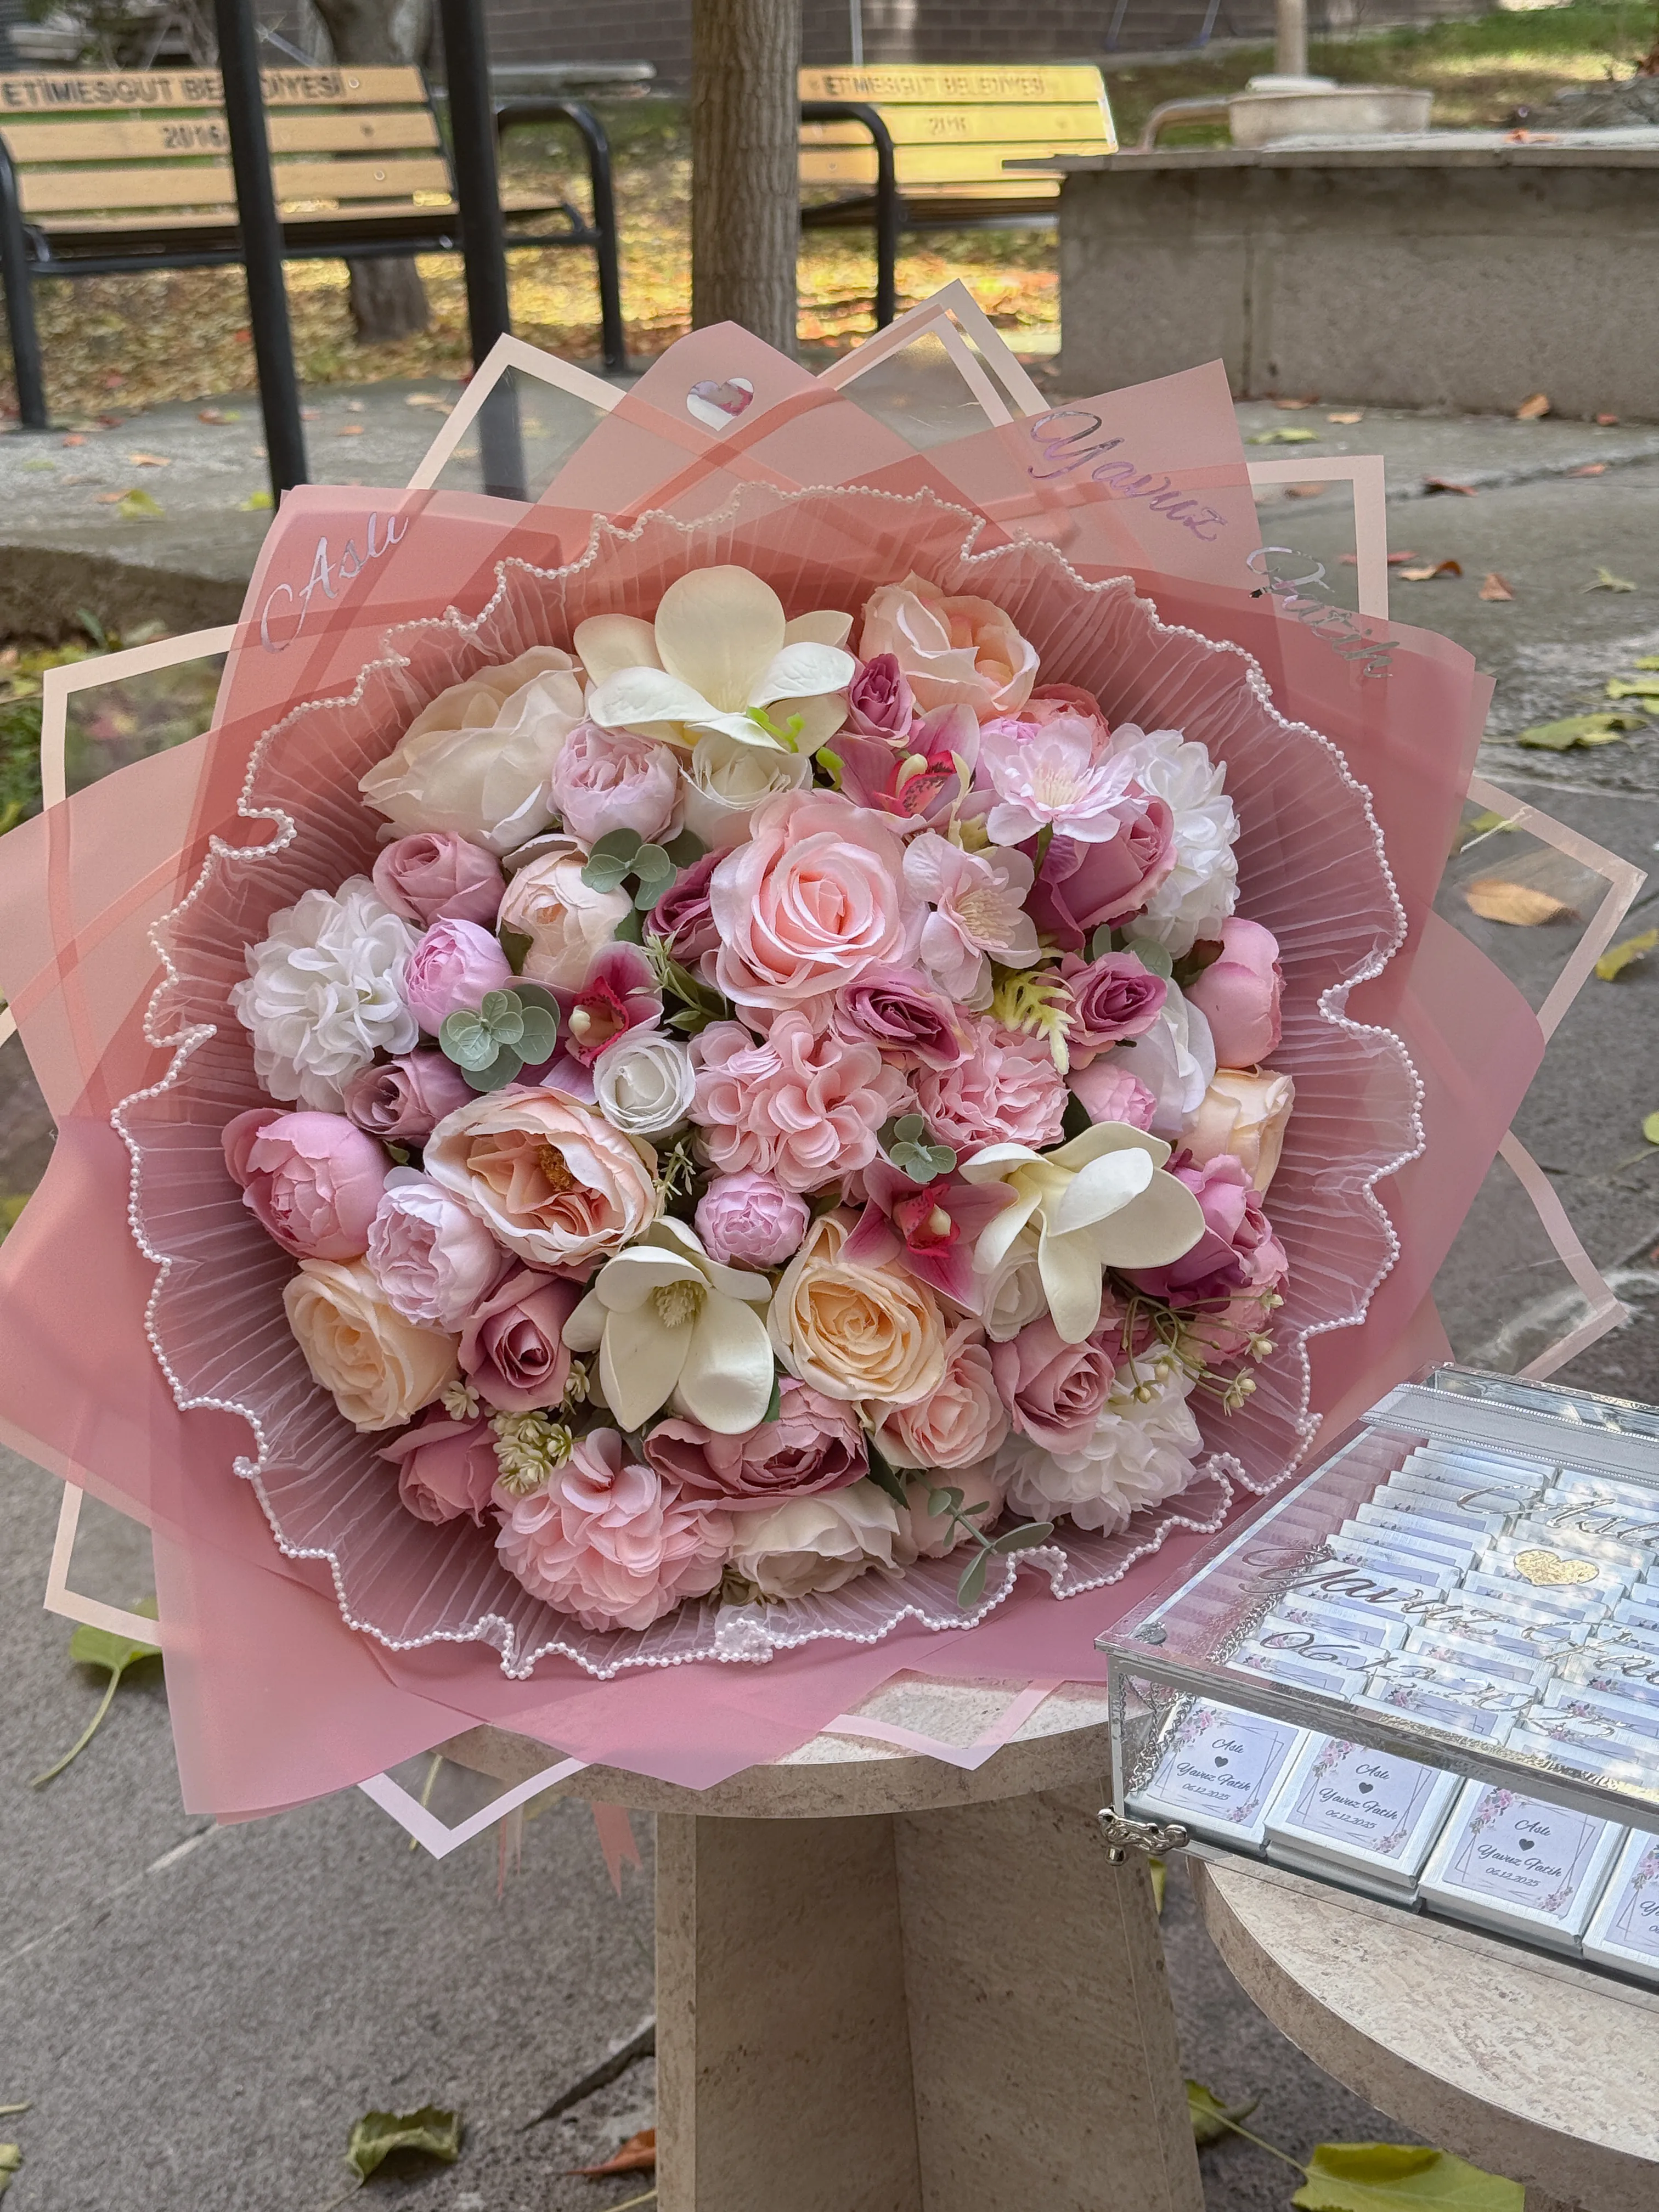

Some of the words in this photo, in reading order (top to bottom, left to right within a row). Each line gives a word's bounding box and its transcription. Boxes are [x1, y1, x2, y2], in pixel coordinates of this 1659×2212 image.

[1028, 410, 1228, 541] Yavuz
[1176, 1762, 1216, 1782] Yavuz
[1217, 1774, 1251, 1791] Fatih
[1319, 1787, 1361, 1809] Yavuz
[1362, 1800, 1398, 1820] Fatih
[1477, 1844, 1523, 1866] Yavuz
[1523, 1858, 1562, 1877] Fatih
